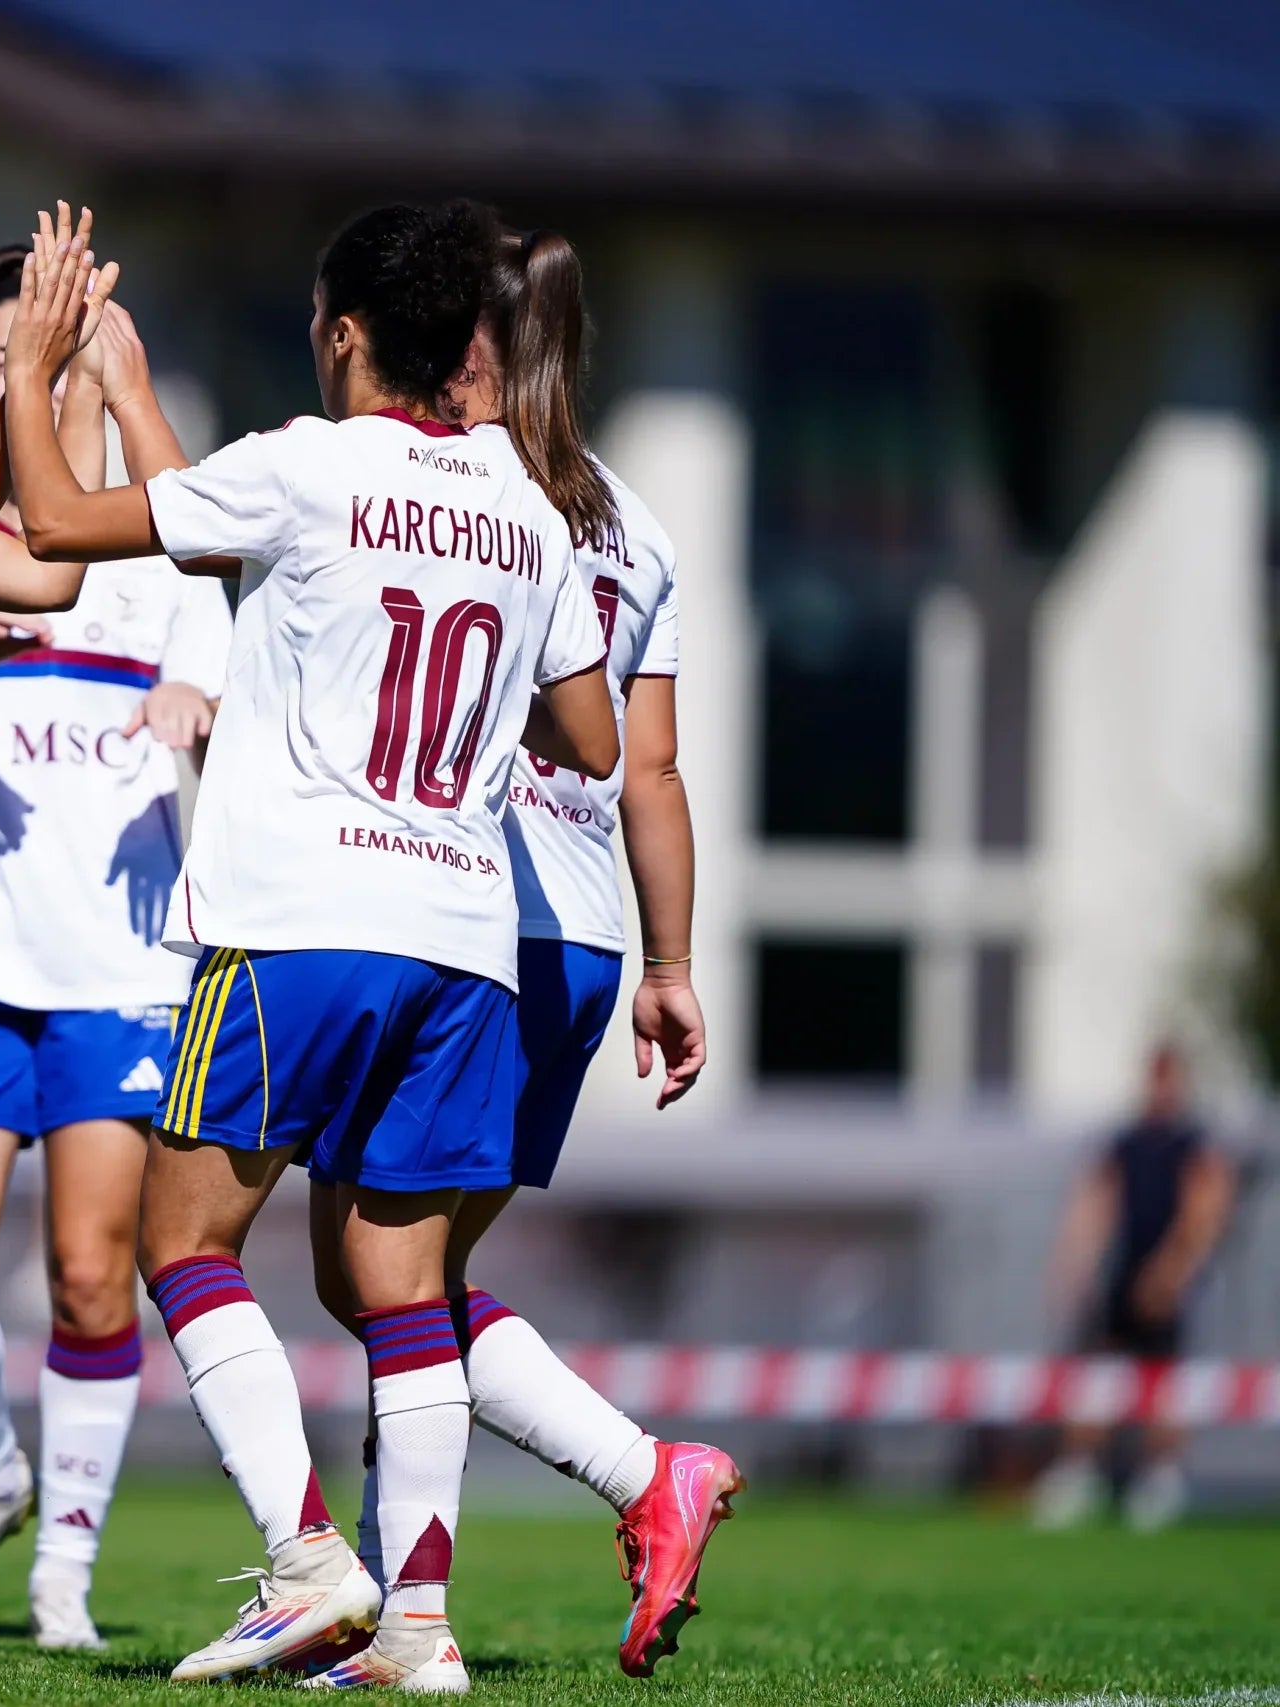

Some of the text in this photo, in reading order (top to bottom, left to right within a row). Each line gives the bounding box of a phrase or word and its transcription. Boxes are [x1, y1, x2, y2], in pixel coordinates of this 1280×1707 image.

[350, 494, 542, 585] KARCHOUNI
[365, 586, 504, 810] 10
[11, 721, 129, 768] MSC
[339, 827, 501, 876] LEMANVISIO SA
